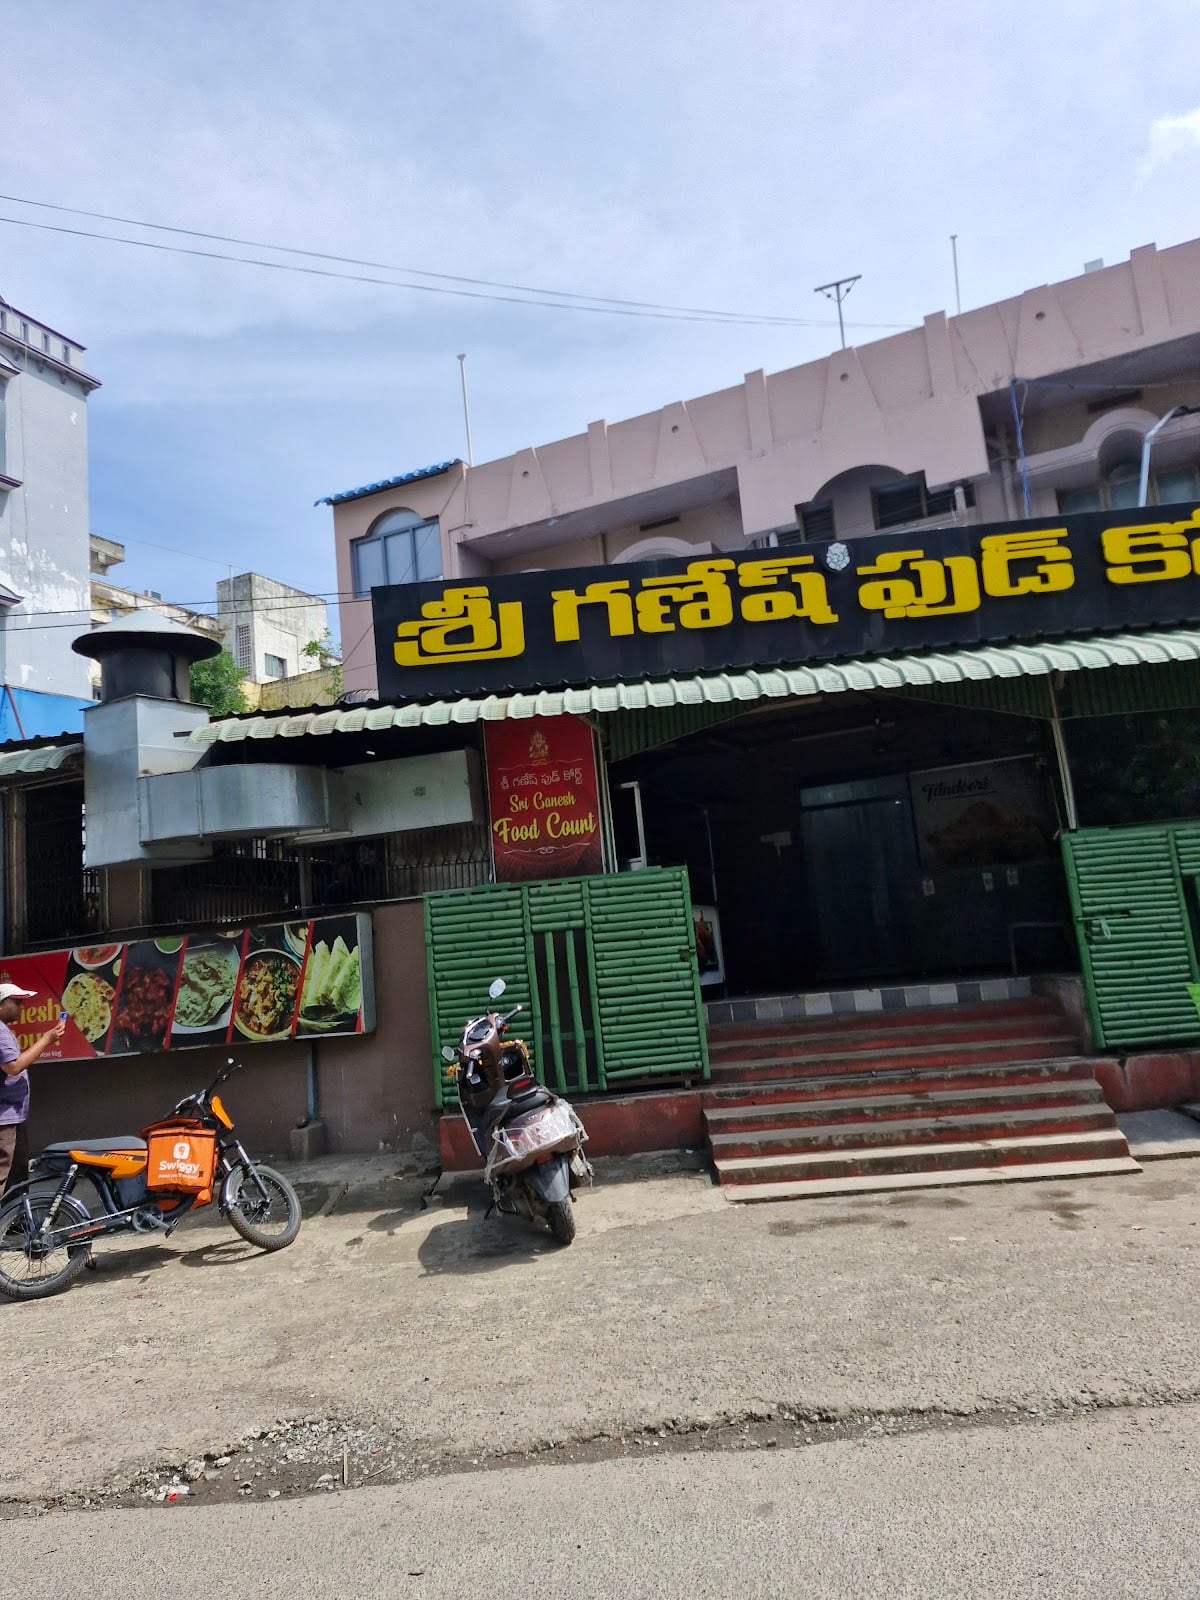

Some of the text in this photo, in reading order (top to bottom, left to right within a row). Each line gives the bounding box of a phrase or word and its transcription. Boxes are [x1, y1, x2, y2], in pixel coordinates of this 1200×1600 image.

[393, 586, 525, 667] శ్రీ
[551, 555, 839, 642] గణేష్
[532, 791, 576, 810] Ganesh
[493, 817, 541, 844] Food
[159, 1160, 200, 1173] Swiggy
